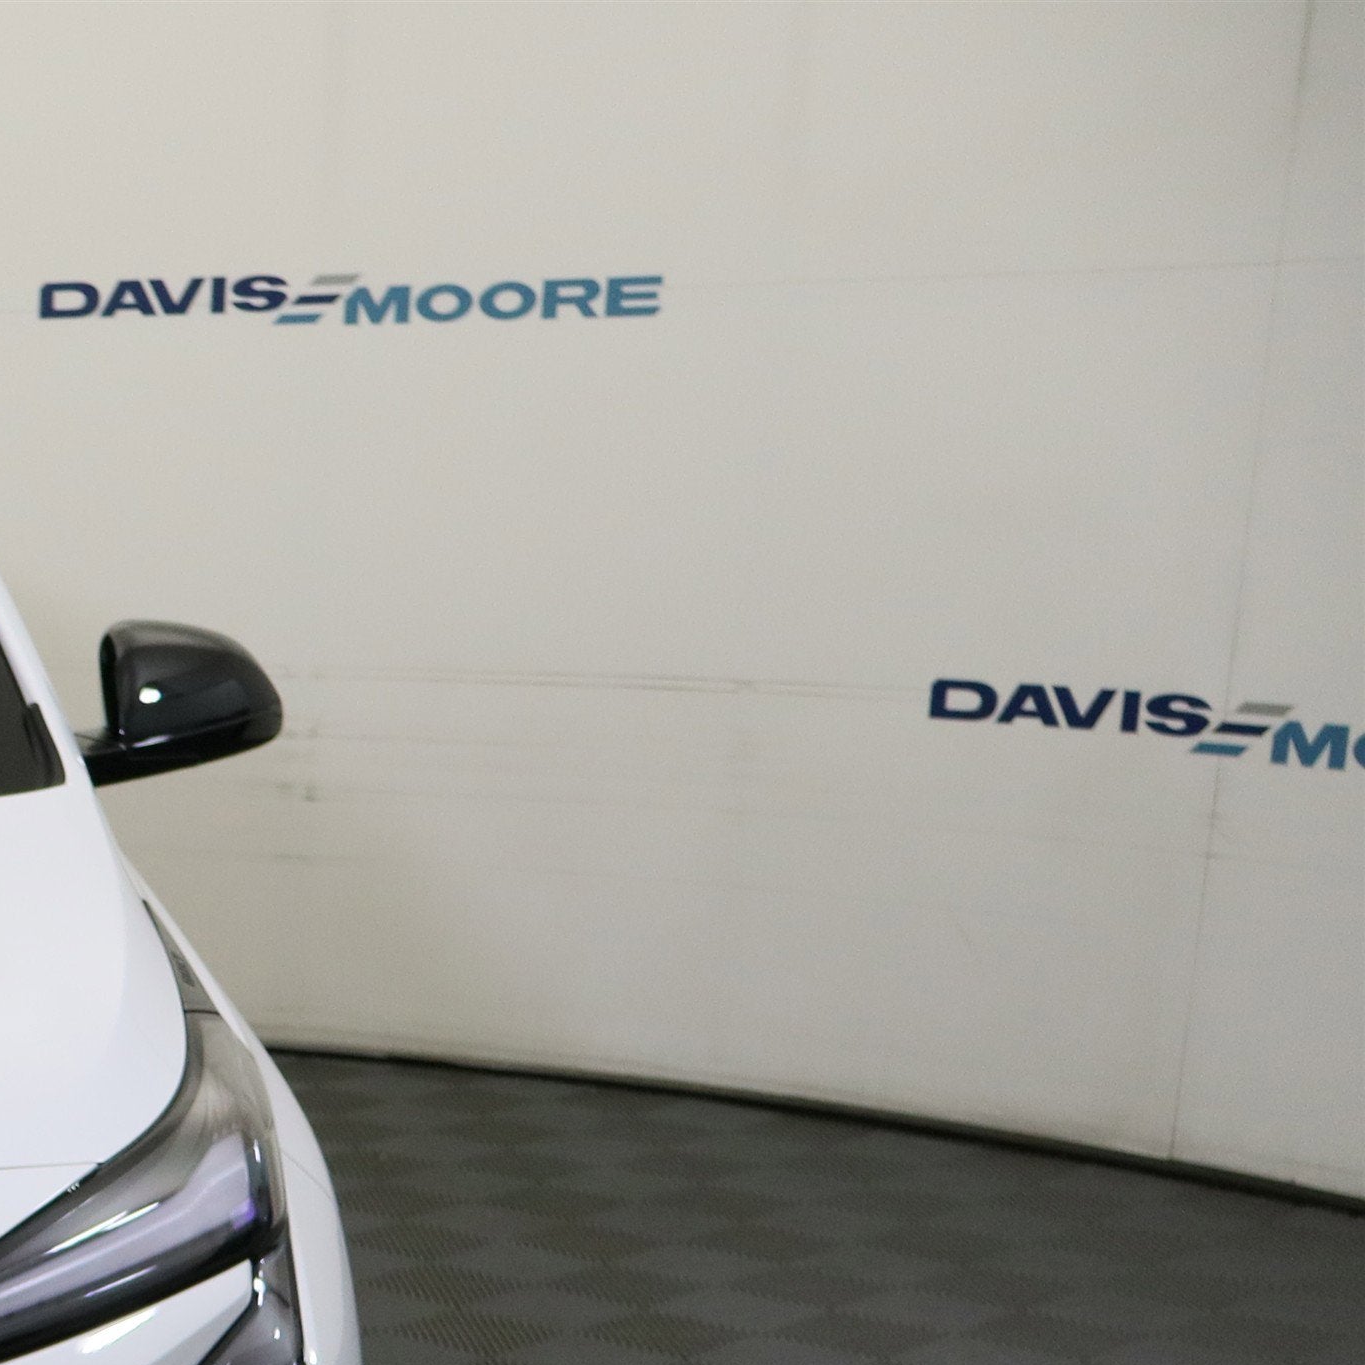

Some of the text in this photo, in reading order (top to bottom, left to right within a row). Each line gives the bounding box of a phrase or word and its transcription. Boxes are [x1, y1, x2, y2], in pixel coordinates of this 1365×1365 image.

[37, 274, 664, 326] DAVIS MOORE
[927, 678, 1213, 738] DAVIS
